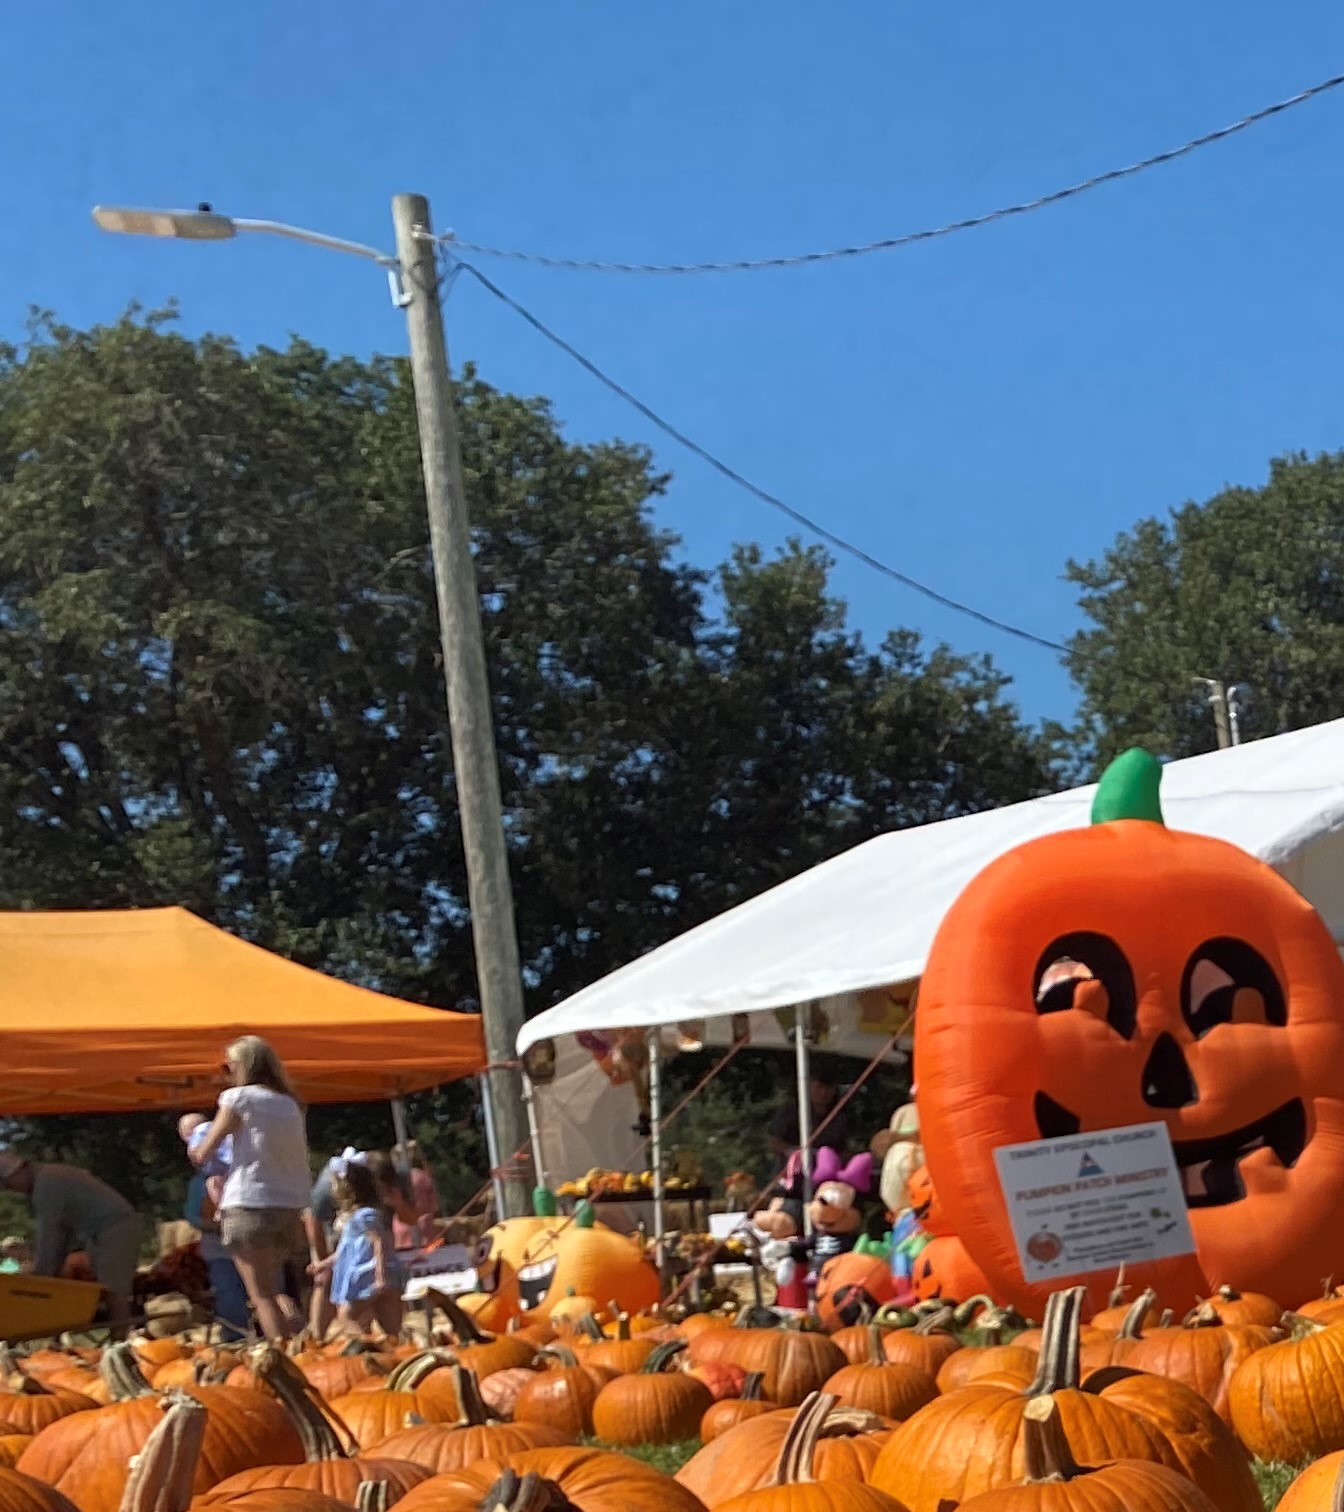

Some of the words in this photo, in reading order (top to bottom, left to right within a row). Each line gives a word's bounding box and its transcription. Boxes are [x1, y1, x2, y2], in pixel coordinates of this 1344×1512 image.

[1010, 1147, 1051, 1160] TRINITY
[1054, 1137, 1110, 1153] EPISCOPAL
[1112, 1129, 1157, 1143] CHURCH
[1015, 1185, 1071, 1200] PUMPKIN
[1075, 1177, 1112, 1191] PATCH
[1115, 1167, 1168, 1185] MINISTRY
